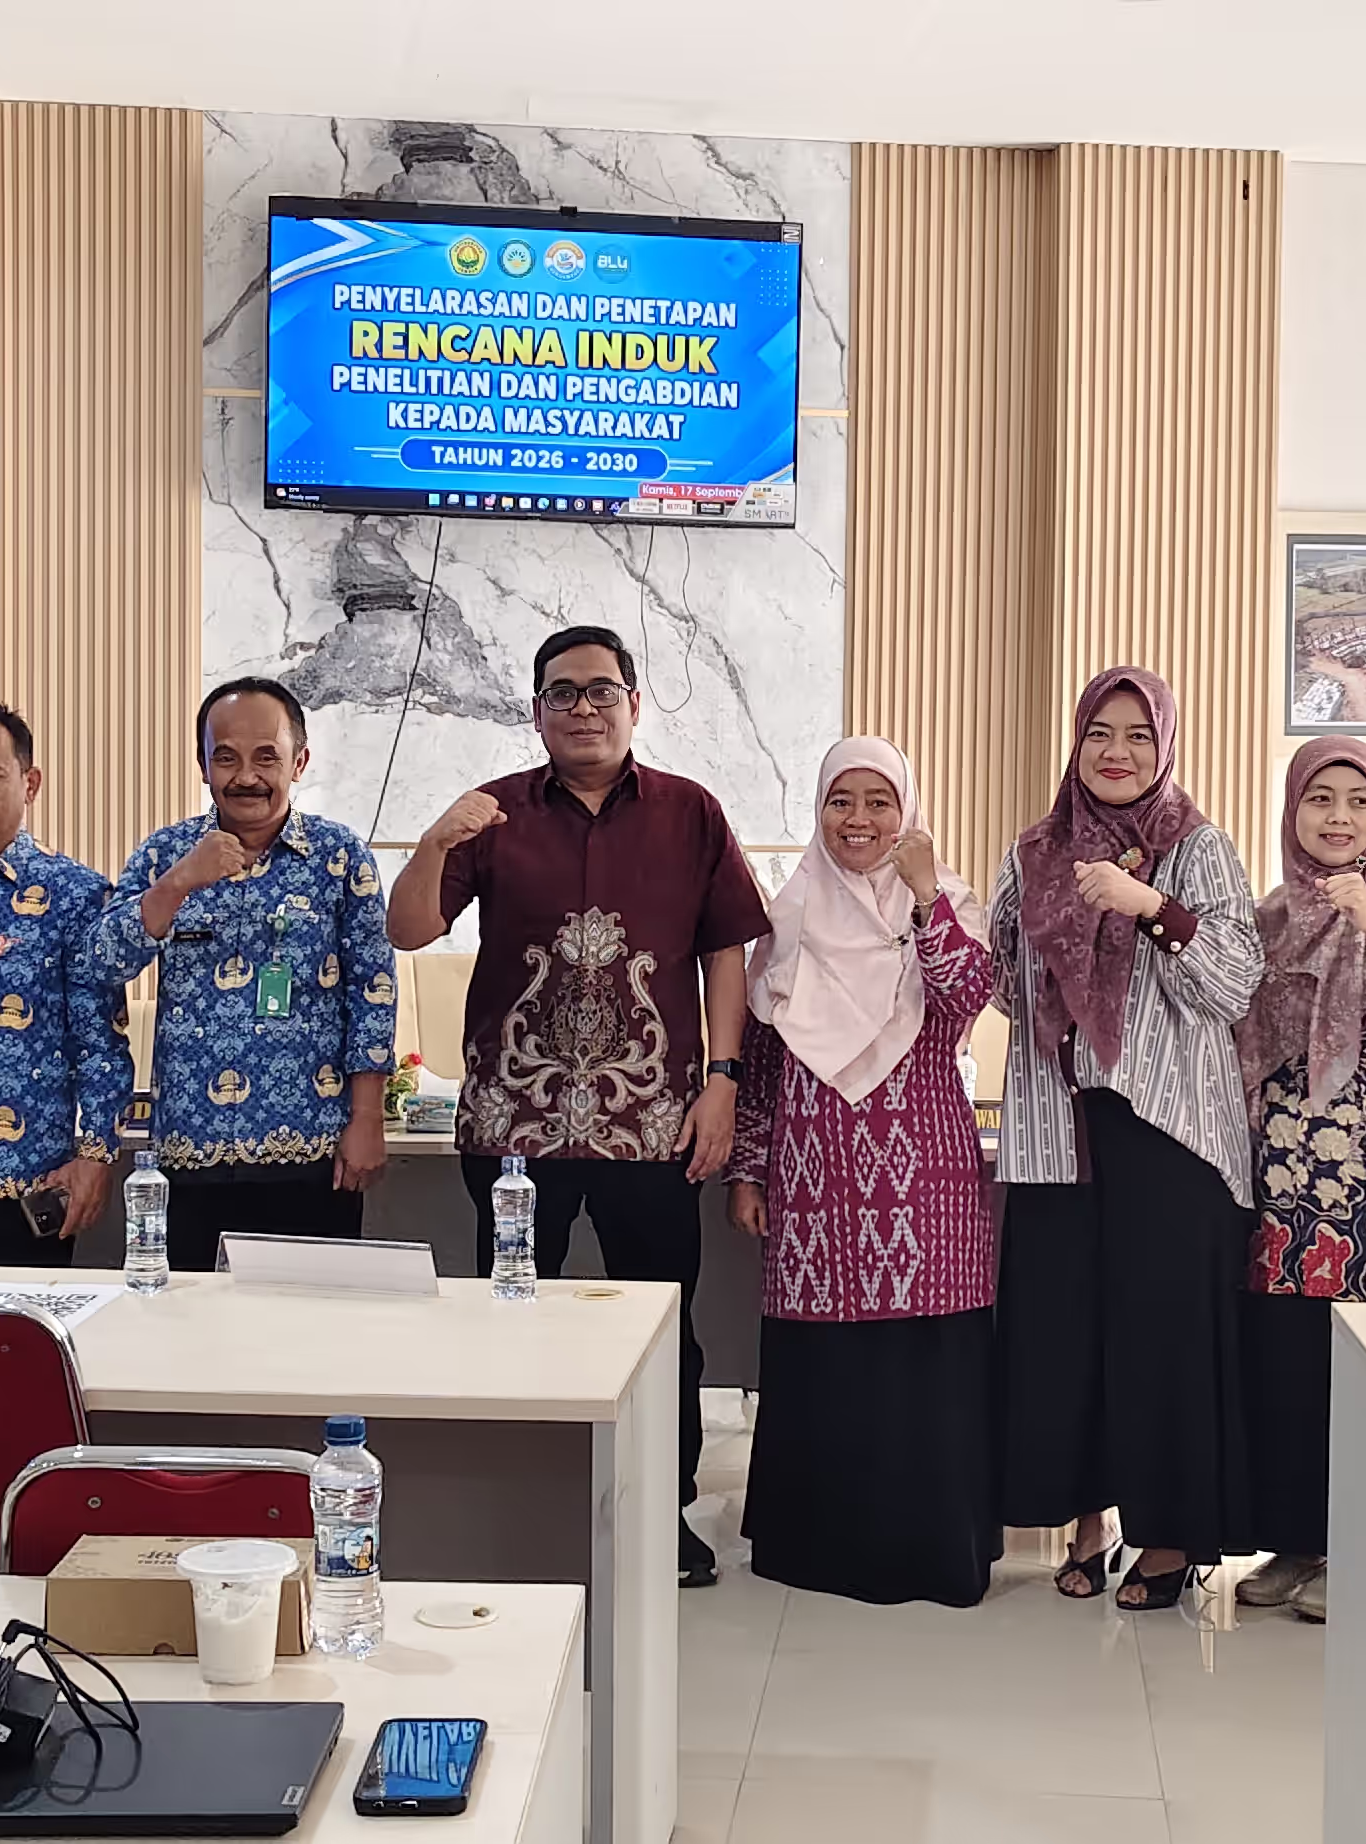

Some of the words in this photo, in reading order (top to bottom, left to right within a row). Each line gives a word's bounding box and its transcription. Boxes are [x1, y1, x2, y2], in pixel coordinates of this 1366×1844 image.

[334, 284, 529, 317] PENYELARASAN
[536, 294, 588, 320] DAN
[594, 297, 737, 327] PENETAPAN
[351, 320, 567, 367] RENCANA
[577, 330, 718, 374] INDUK
[332, 365, 491, 397] PENELITIAN
[500, 373, 557, 400] DAN
[566, 376, 738, 408] PENGABDIAN
[388, 402, 497, 431] KEPADA
[504, 408, 685, 440] MASYARAKAT
[432, 446, 503, 466] TAHUN
[511, 449, 563, 468] 2026
[586, 452, 638, 472] 2030
[642, 485, 677, 497] Kamis,
[681, 486, 692, 495] 17
[695, 487, 743, 499] Septemb
